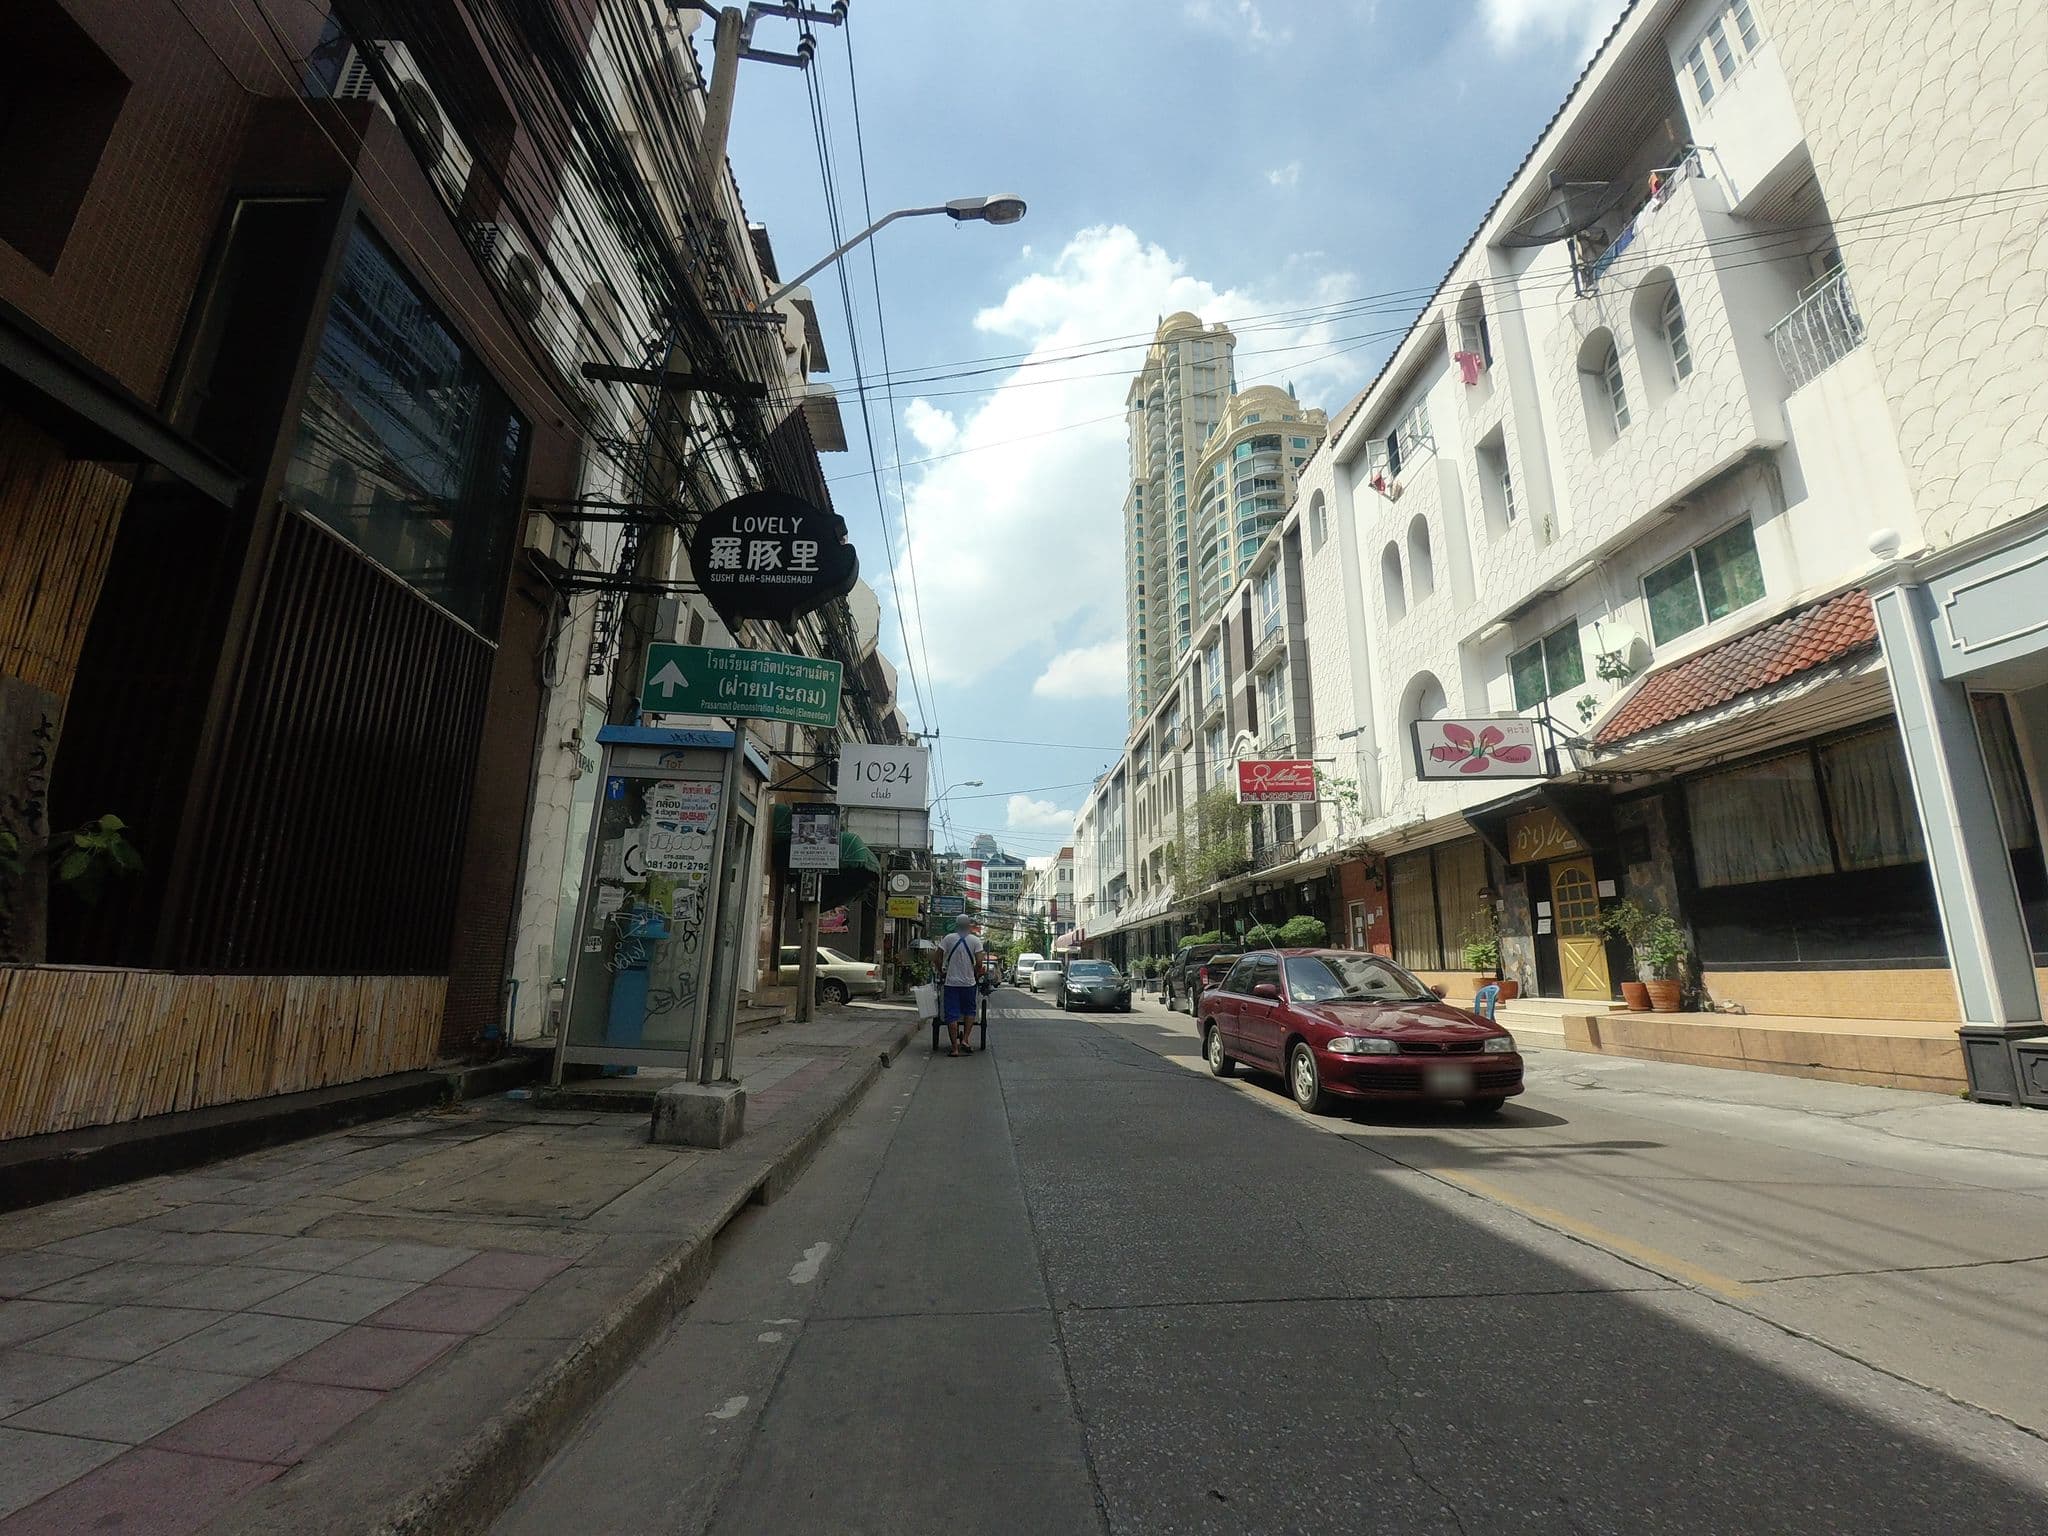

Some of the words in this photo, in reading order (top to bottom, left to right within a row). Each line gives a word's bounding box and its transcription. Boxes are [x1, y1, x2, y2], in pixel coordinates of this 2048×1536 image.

[732, 516, 803, 534] LOVELY
[708, 537, 820, 572] 羅豚里
[710, 573, 735, 583] SUSHI
[738, 574, 813, 584] BAR-SHABUSHABU
[718, 675, 826, 708] (ฝ่ายประถม)
[733, 701, 774, 713] Demonstration
[775, 704, 795, 716] School
[796, 707, 831, 722] (Elementary)
[853, 760, 913, 785] 1024
[870, 789, 892, 800] club
[1517, 816, 1568, 858] かりん
